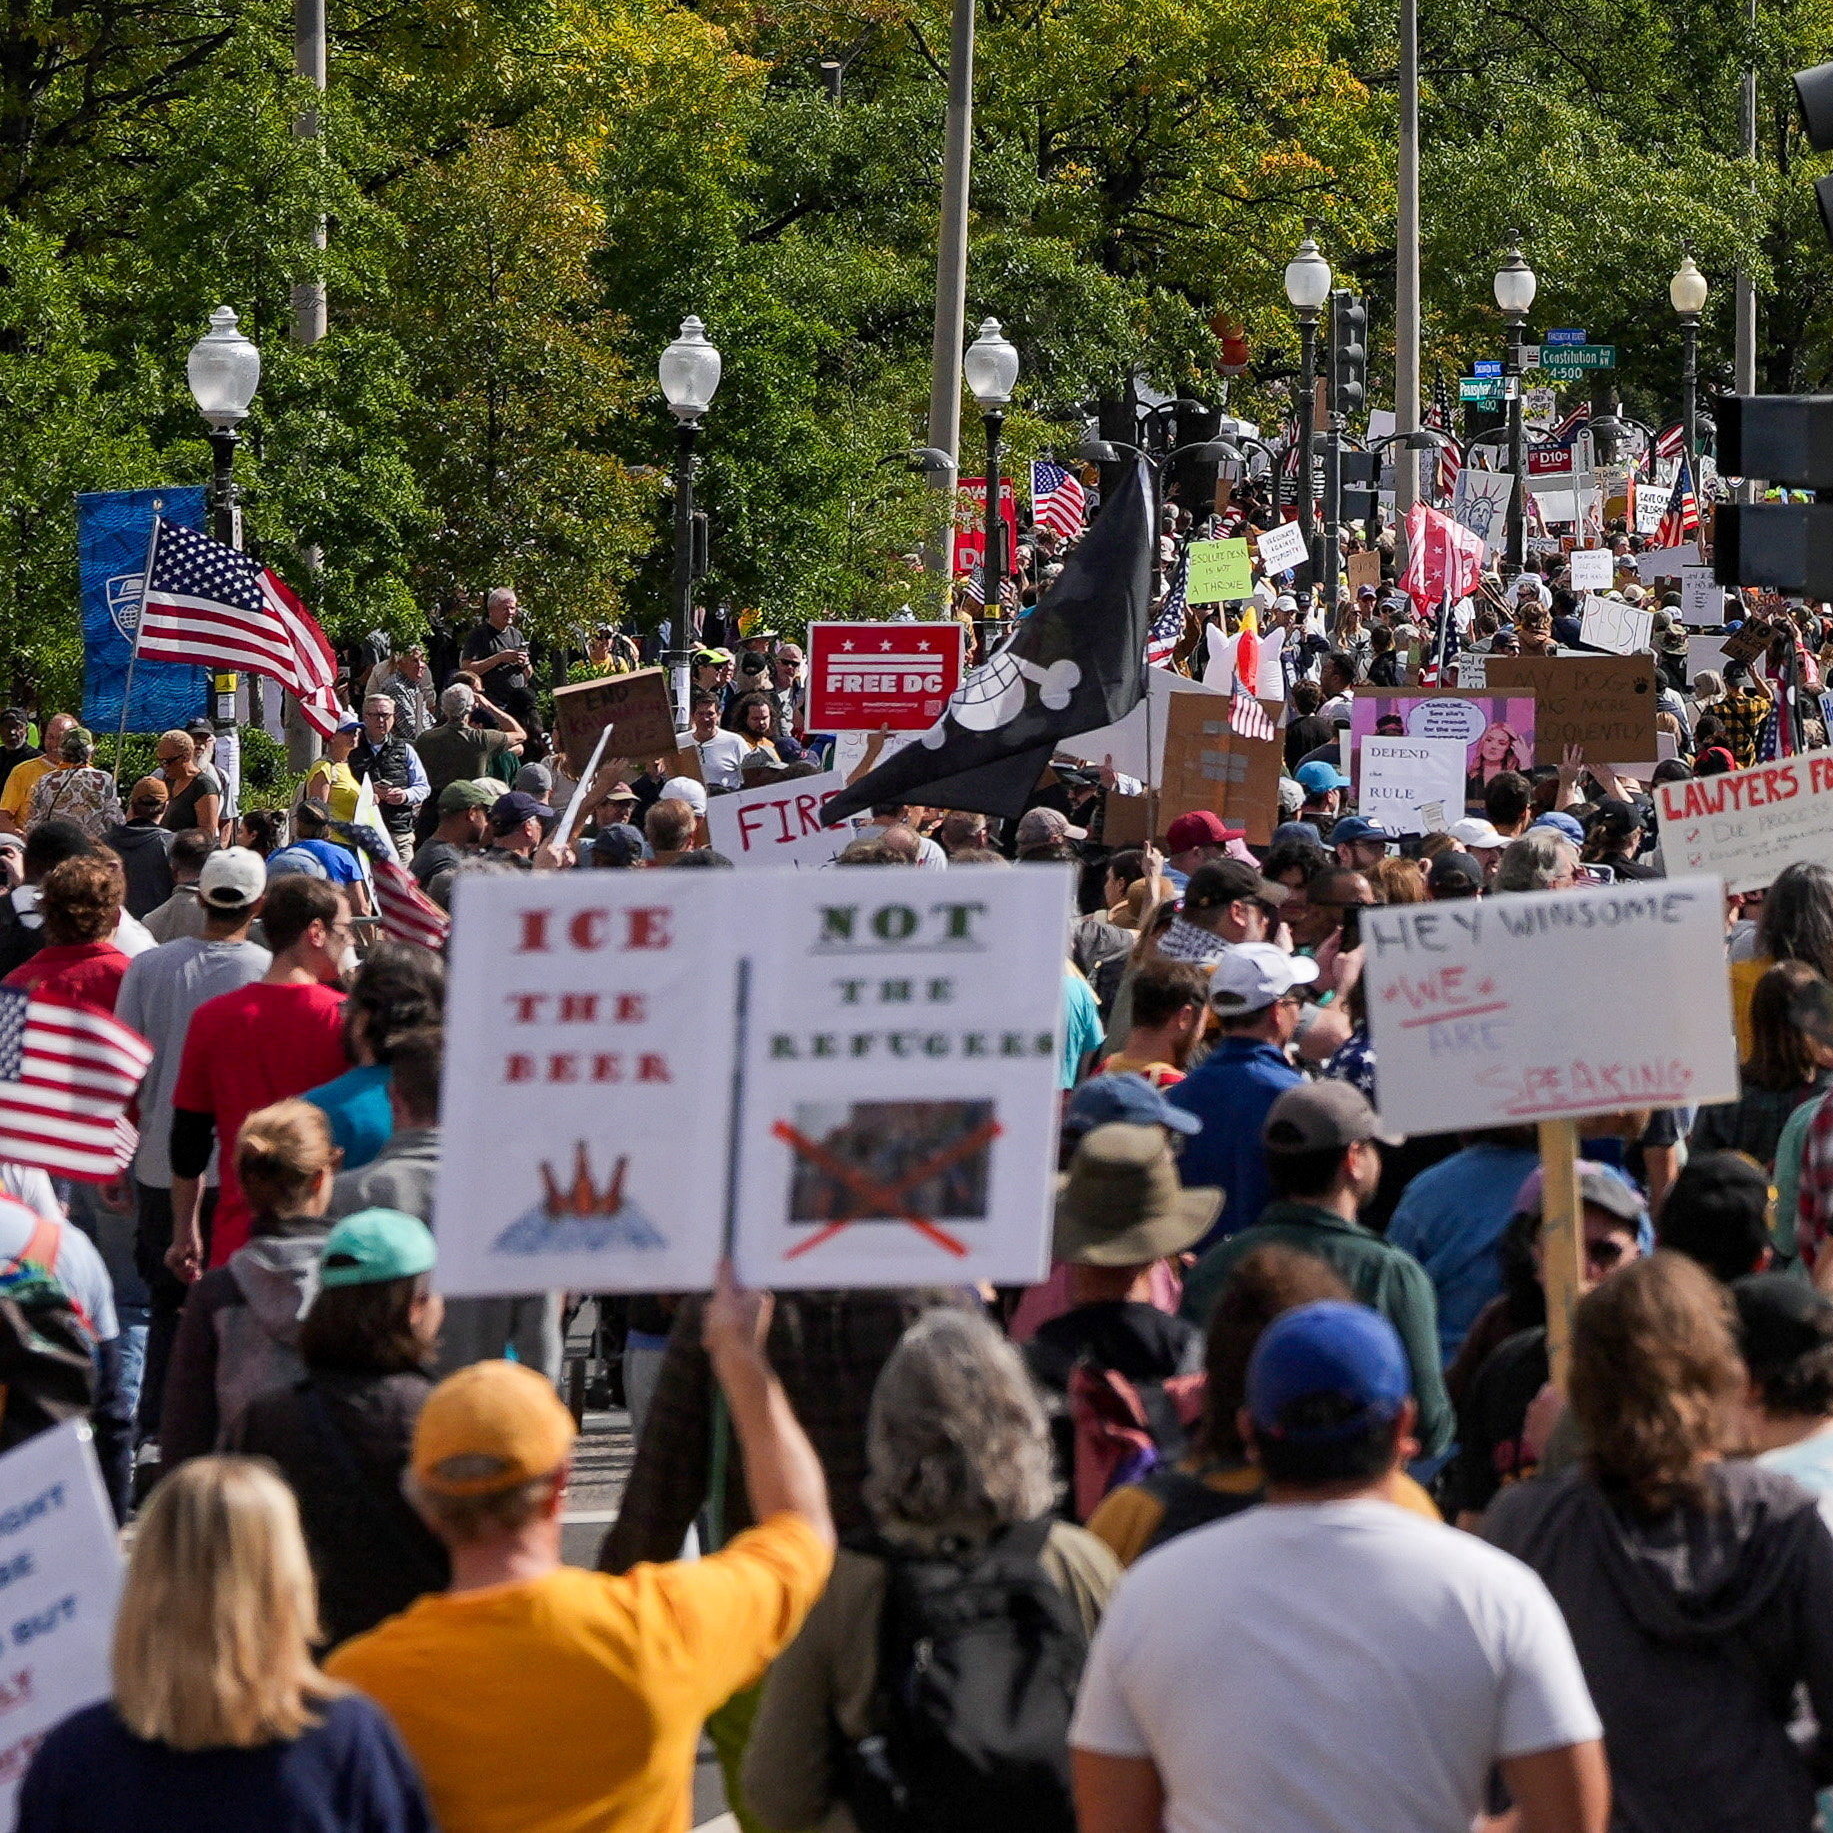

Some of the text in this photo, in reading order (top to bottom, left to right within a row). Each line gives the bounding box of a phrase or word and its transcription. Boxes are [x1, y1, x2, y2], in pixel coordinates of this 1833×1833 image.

[1542, 350, 1597, 365] Constitution
[1203, 580, 1245, 593] THRONE
[1587, 599, 1650, 651] RESIST
[826, 674, 943, 693] FREE DC
[1370, 747, 1429, 760] DEFEND
[1369, 787, 1416, 800] RULE
[1661, 766, 1799, 821] LAWYERS
[517, 906, 673, 954] ICE
[816, 902, 988, 945] NOT
[1372, 892, 1694, 958] HEY WINSOME
[834, 977, 954, 1005] THE
[505, 993, 650, 1025] THE
[770, 1032, 1054, 1060] REFUGEES
[501, 1052, 673, 1084] BEER
[1476, 1059, 1688, 1111] SPEAKING
